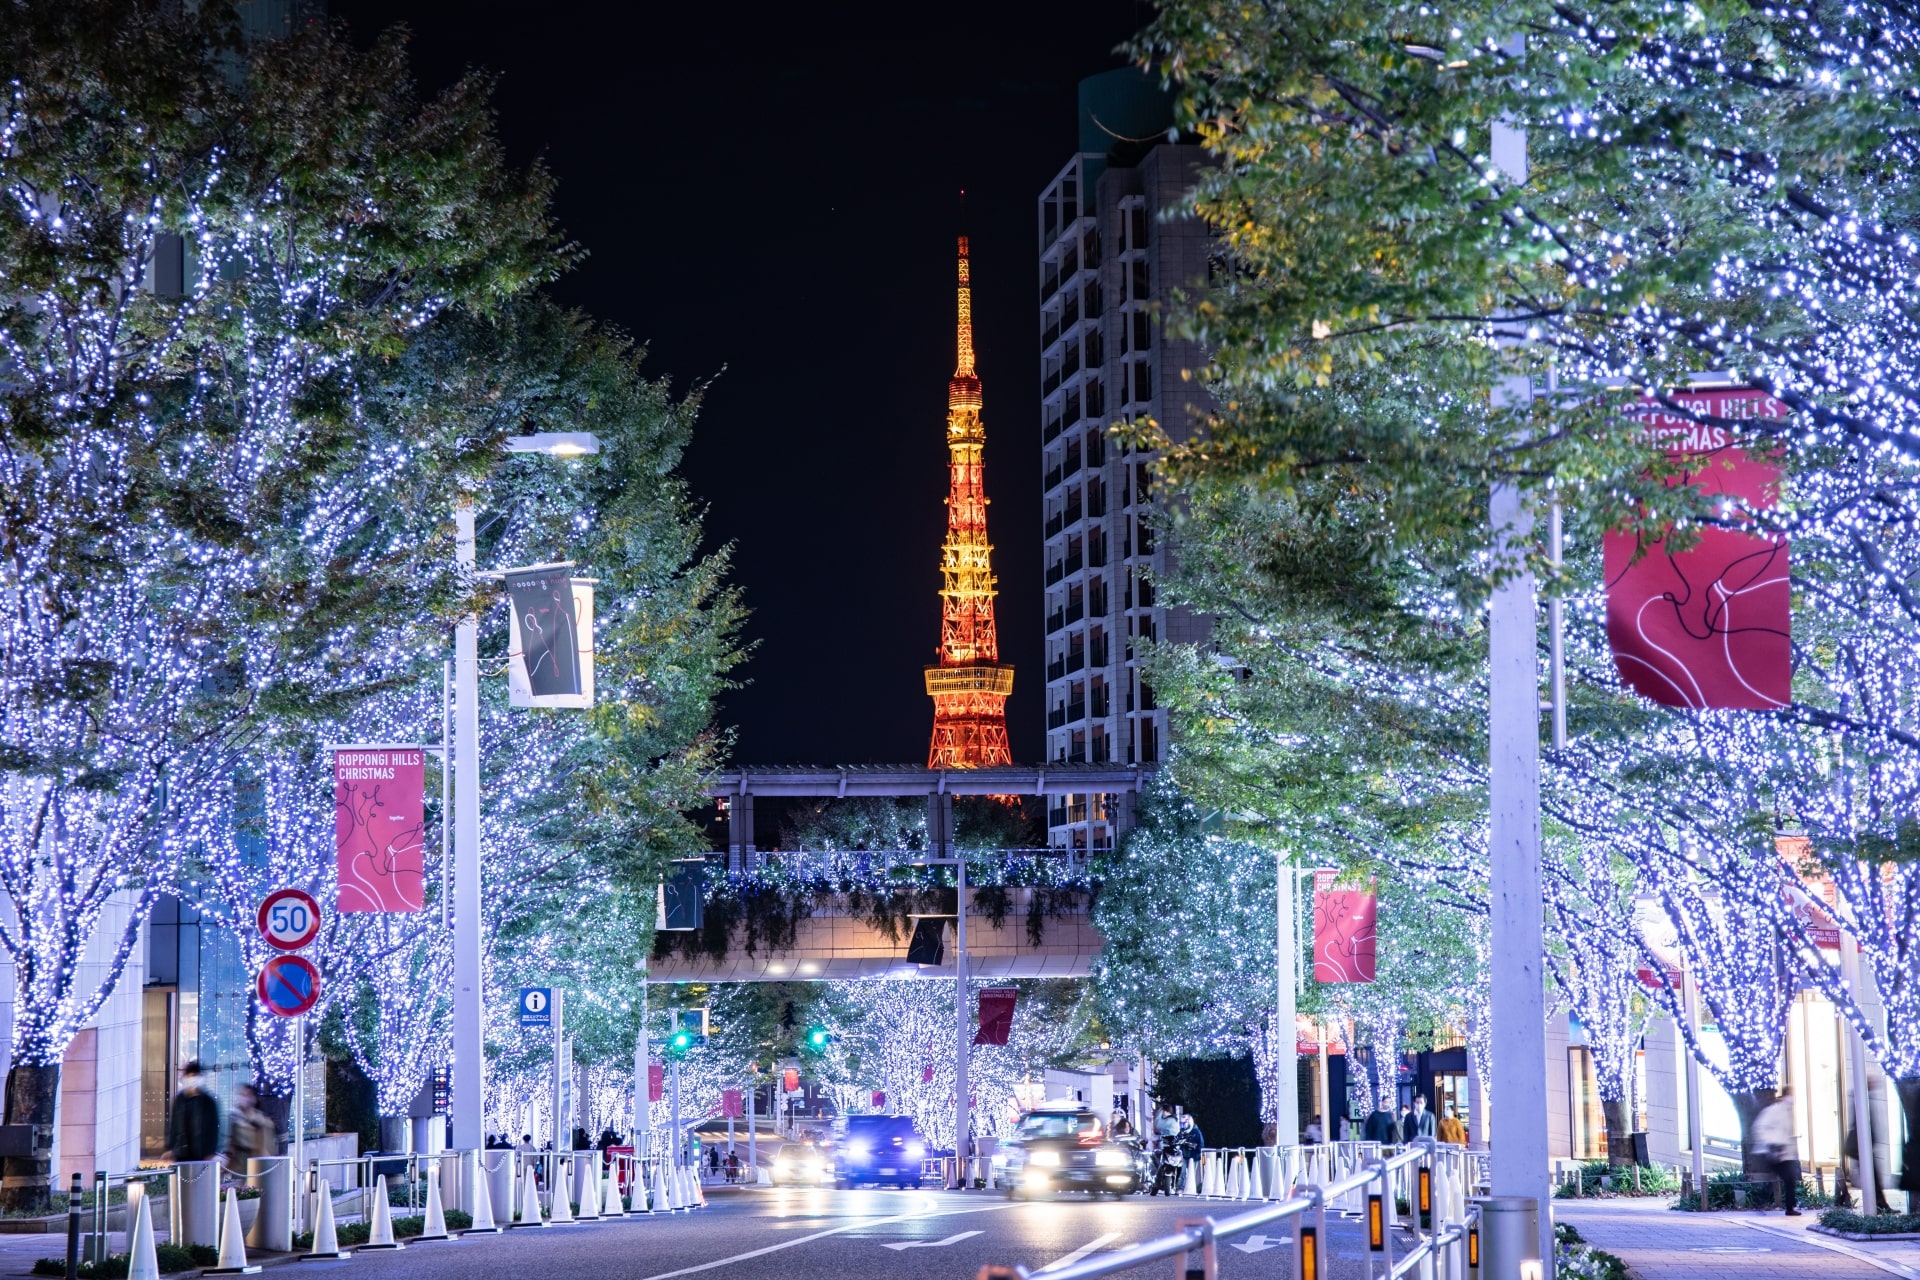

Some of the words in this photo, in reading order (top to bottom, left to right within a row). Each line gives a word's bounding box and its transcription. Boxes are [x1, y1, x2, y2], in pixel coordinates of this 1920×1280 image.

[338, 753, 388, 766] ROPPONGI
[392, 753, 420, 766] HILLS
[339, 767, 395, 780] CHRISTMAS
[272, 906, 307, 933] 50
